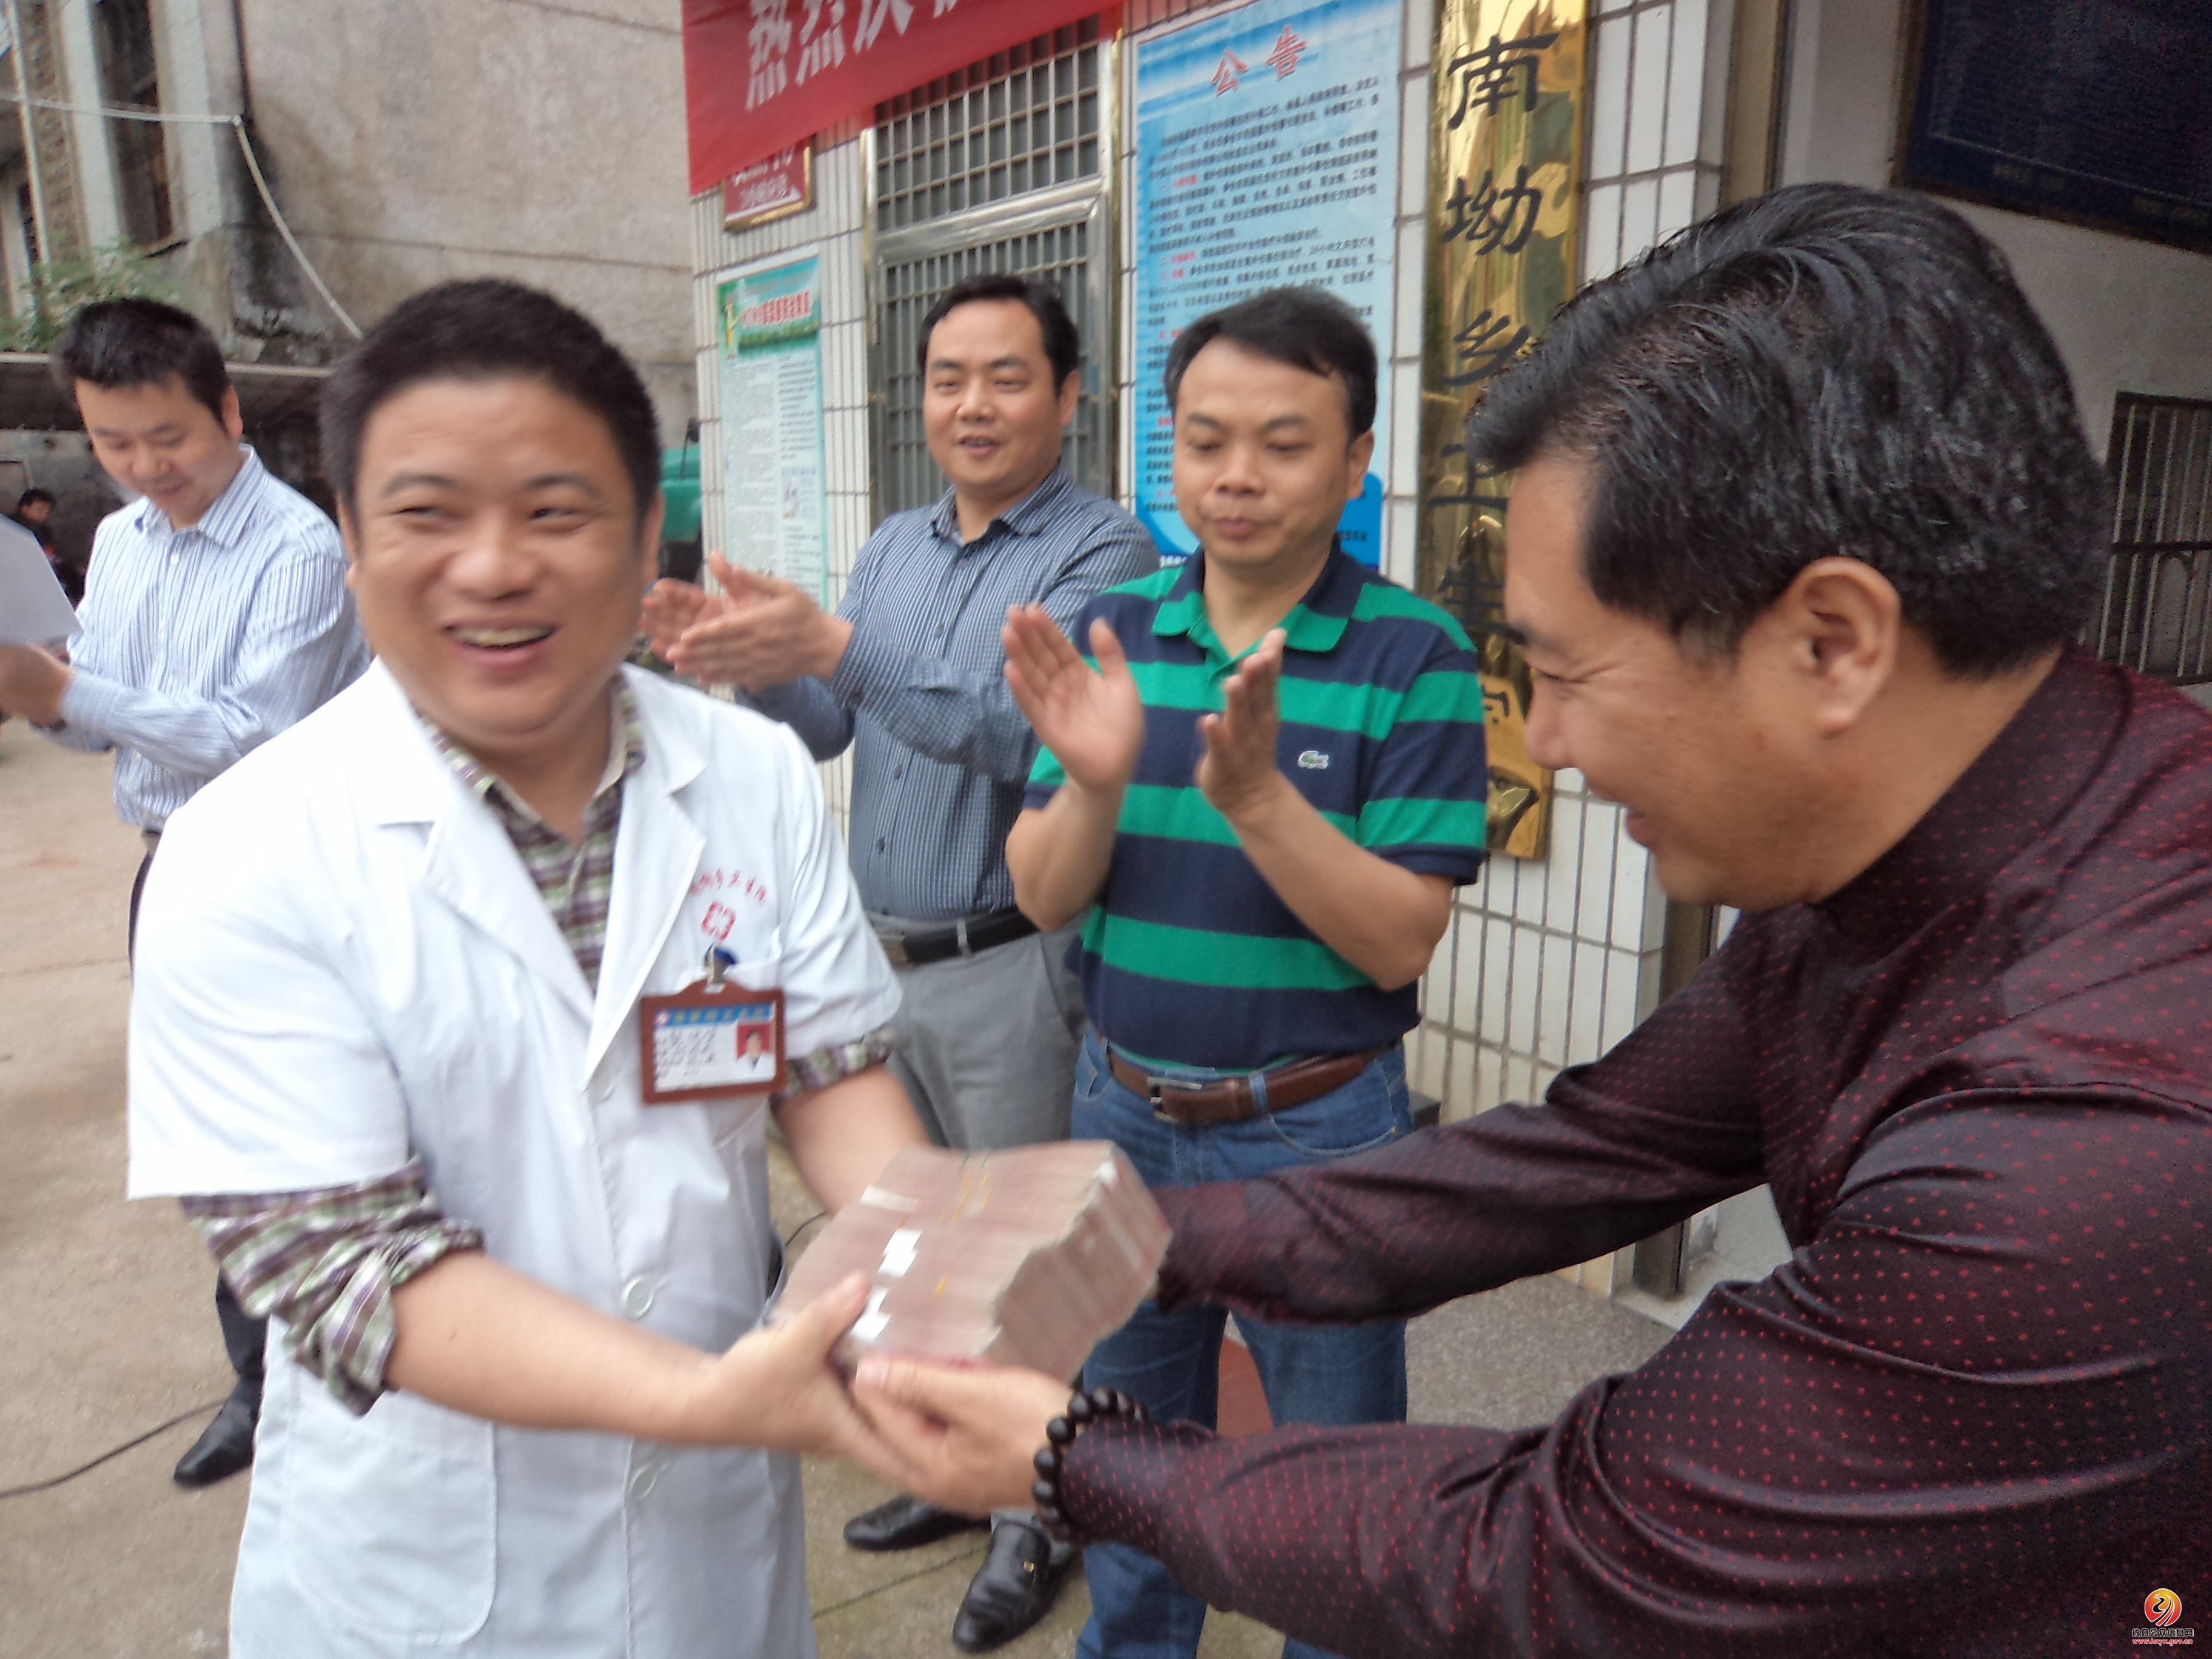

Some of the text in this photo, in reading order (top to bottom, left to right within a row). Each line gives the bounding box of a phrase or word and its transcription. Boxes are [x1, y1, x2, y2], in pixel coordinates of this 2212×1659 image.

[745, 0, 958, 112] 热烈
[1211, 25, 1307, 96] 公告
[1426, 32, 1559, 720] 南坳乡卫生
